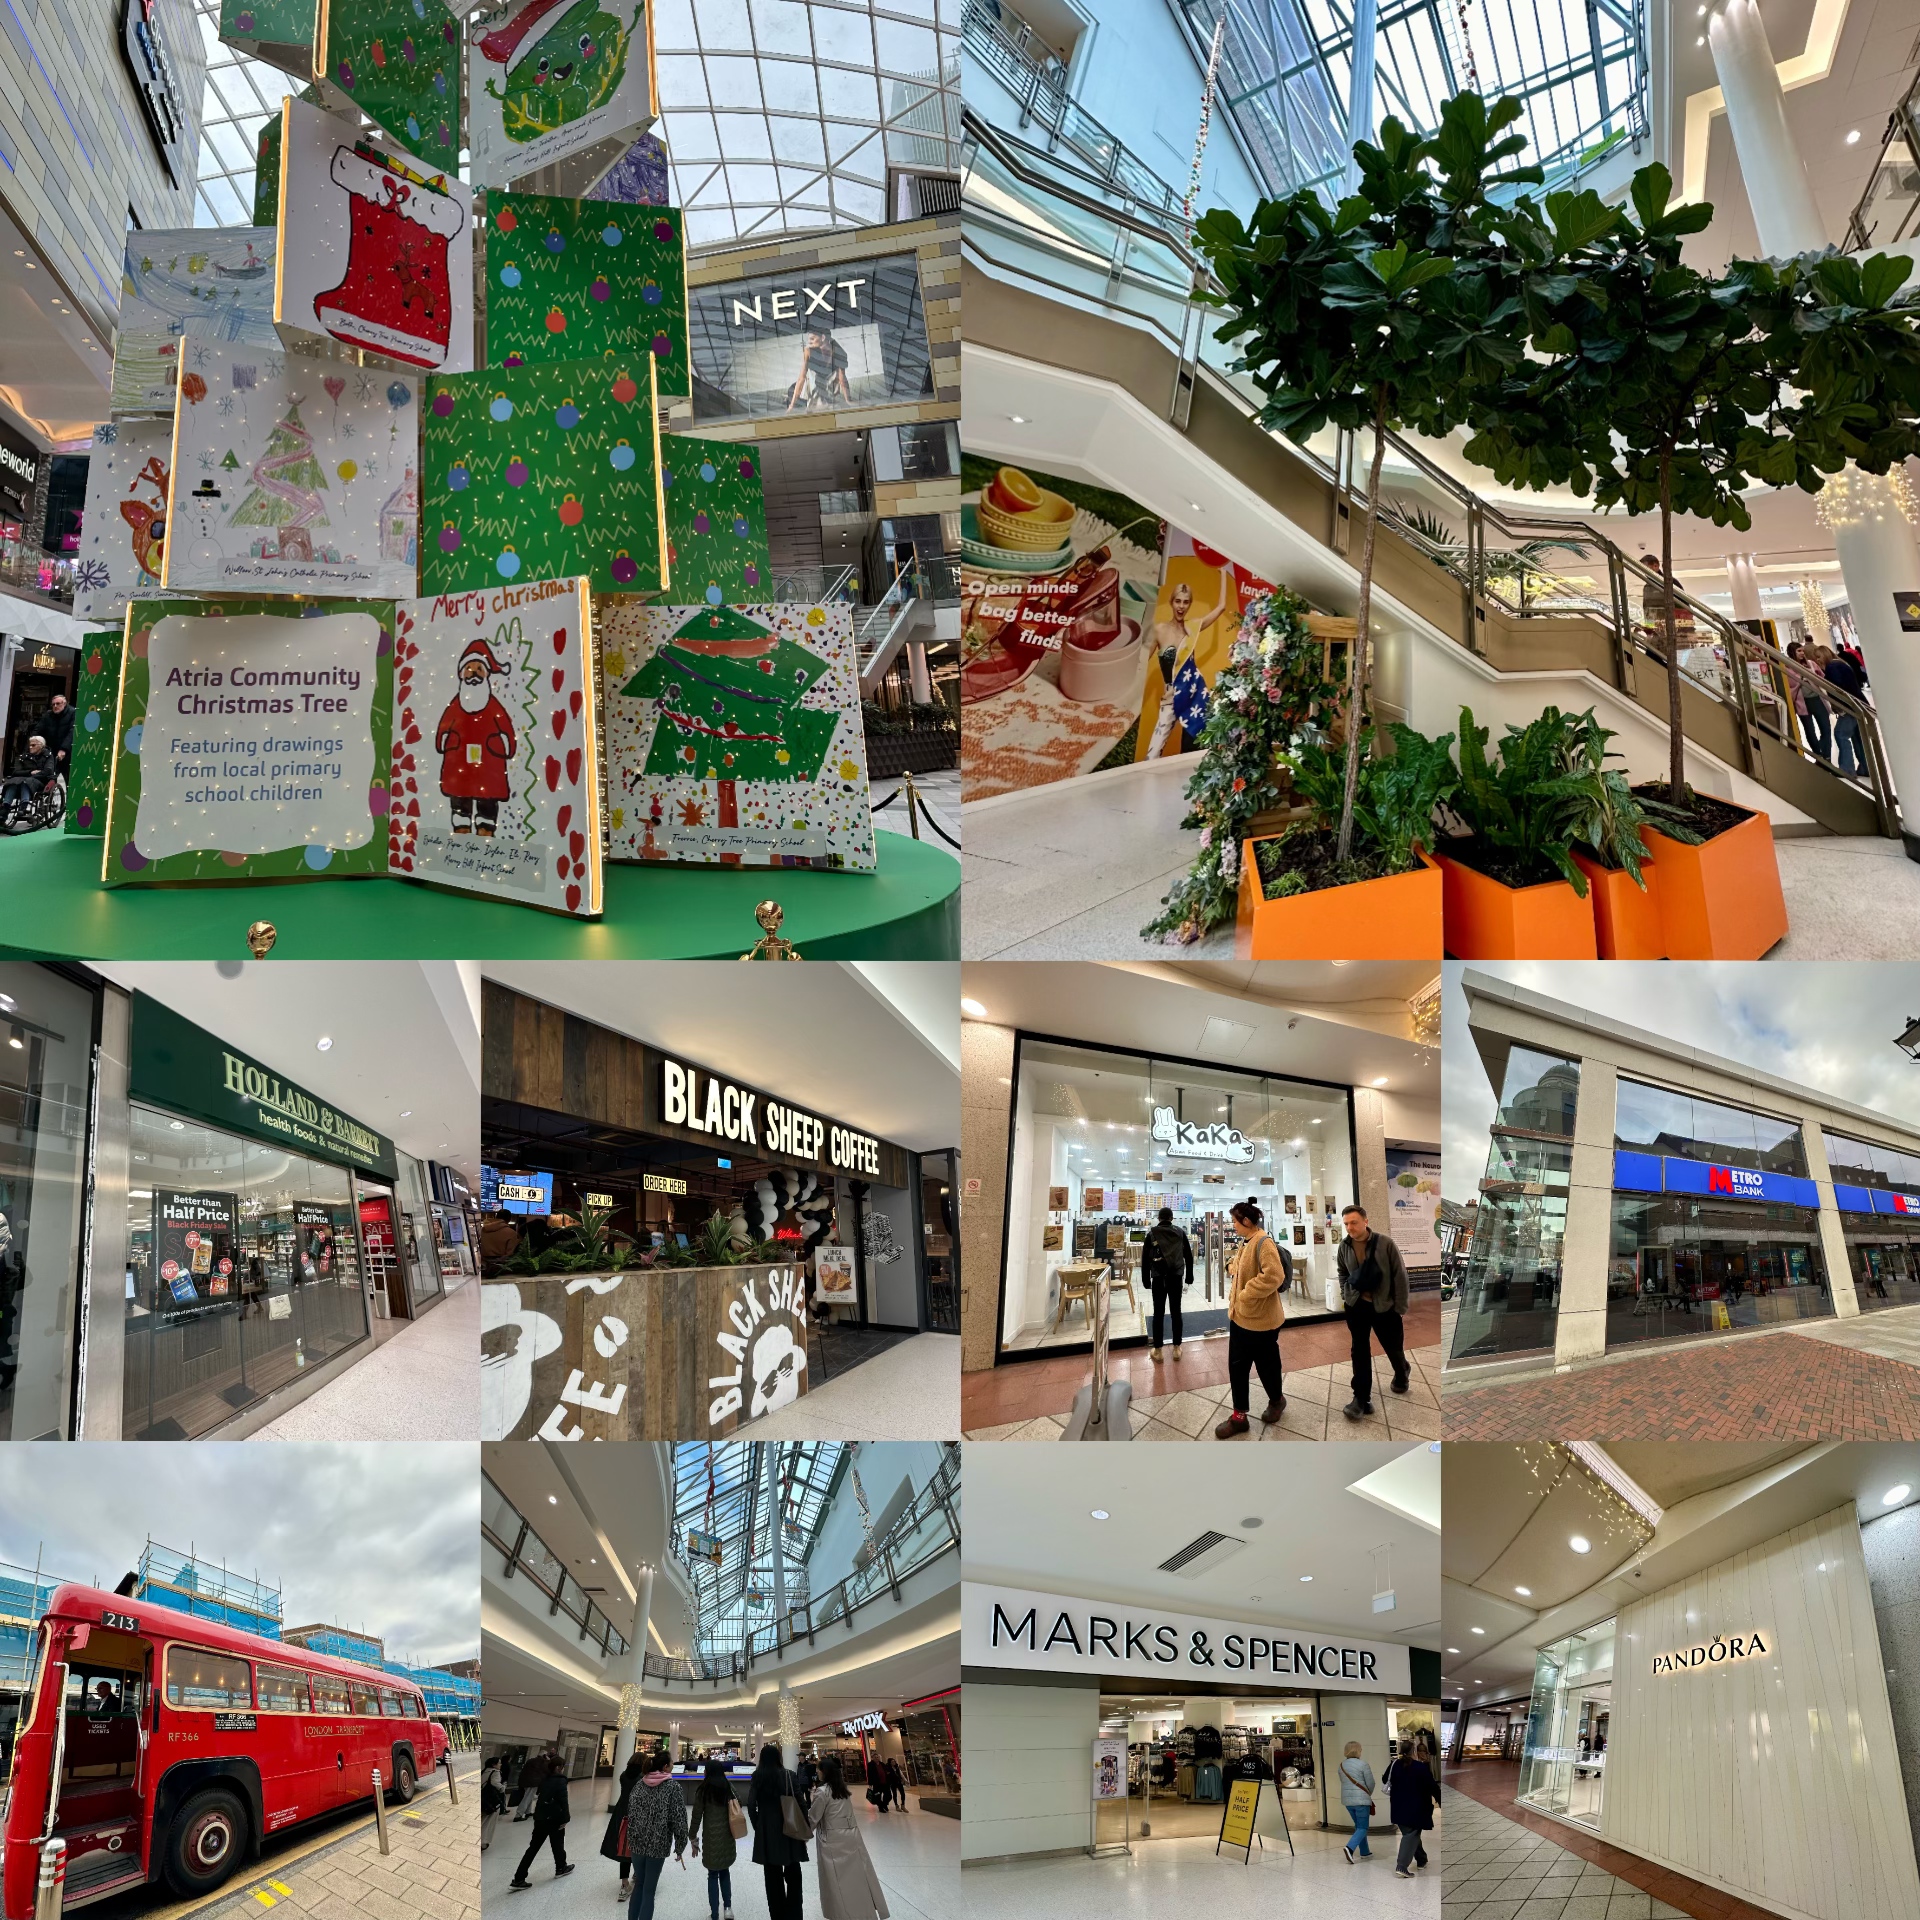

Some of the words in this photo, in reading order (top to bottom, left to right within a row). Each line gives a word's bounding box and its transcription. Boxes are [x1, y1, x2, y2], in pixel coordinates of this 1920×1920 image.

[471, 5, 508, 30] every
[733, 279, 865, 326] NEXT
[967, 579, 1022, 597] Open
[1026, 580, 1079, 595] minds
[431, 590, 485, 626] Merry
[492, 580, 574, 613] christmas
[978, 602, 1018, 622] bag
[1021, 607, 1077, 626] better
[1019, 628, 1063, 650] finds
[165, 667, 223, 686] Atria
[230, 666, 360, 690] Community
[177, 694, 294, 714] Christmas
[300, 693, 348, 713] Tree
[171, 738, 257, 756] Featuring
[263, 737, 343, 755] drawings
[174, 762, 216, 778] from
[224, 761, 265, 777] local
[271, 761, 341, 780] primary
[185, 786, 245, 803] school
[250, 784, 322, 801] children
[701, 835, 727, 846] Cherry
[728, 836, 743, 844] Tree
[745, 837, 779, 848] Primary
[780, 838, 805, 847] School
[222, 1051, 319, 1124] HOLLAND
[320, 1107, 334, 1134] &
[664, 1059, 757, 1145] BLACK
[766, 1101, 824, 1161] SHEEP
[831, 1125, 880, 1176] COFFEE
[258, 1109, 292, 1134] health
[293, 1123, 317, 1143] foods
[318, 1136, 326, 1147] &
[327, 1141, 349, 1156] natural
[350, 1150, 373, 1165] remedies
[1176, 1123, 1242, 1146] KaKa
[1409, 1160, 1422, 1169] The
[644, 1175, 668, 1191] ORDER
[669, 1179, 686, 1194] HERE
[1709, 1166, 1763, 1193] METRO
[173, 1194, 201, 1206] Better
[201, 1198, 221, 1207] than
[500, 1186, 520, 1199] CASH
[587, 1193, 602, 1205] PICK
[603, 1195, 612, 1206] UP
[1734, 1185, 1764, 1197] BANK
[163, 1205, 194, 1220] Half
[197, 1207, 229, 1221] Price
[1893, 1194, 1919, 1213] METRO
[167, 1221, 189, 1229] Black
[190, 1222, 212, 1230] Friday
[297, 1213, 313, 1223] Half
[313, 1214, 329, 1224] Price
[364, 1224, 393, 1235] SALE
[708, 1278, 767, 1426] BLACK
[106, 1613, 134, 1630] 213
[991, 1603, 1180, 1663] MARKS
[1188, 1630, 1216, 1668] &
[1222, 1634, 1379, 1682] SPENCER
[1653, 1633, 1767, 1675] PANDORA
[304, 1725, 333, 1737] LONDON
[336, 1725, 365, 1736] TRANSPORT
[1243, 1762, 1256, 1770] M&S
[1232, 1803, 1249, 1813] PRICE
[1234, 1795, 1250, 1804] HALF
